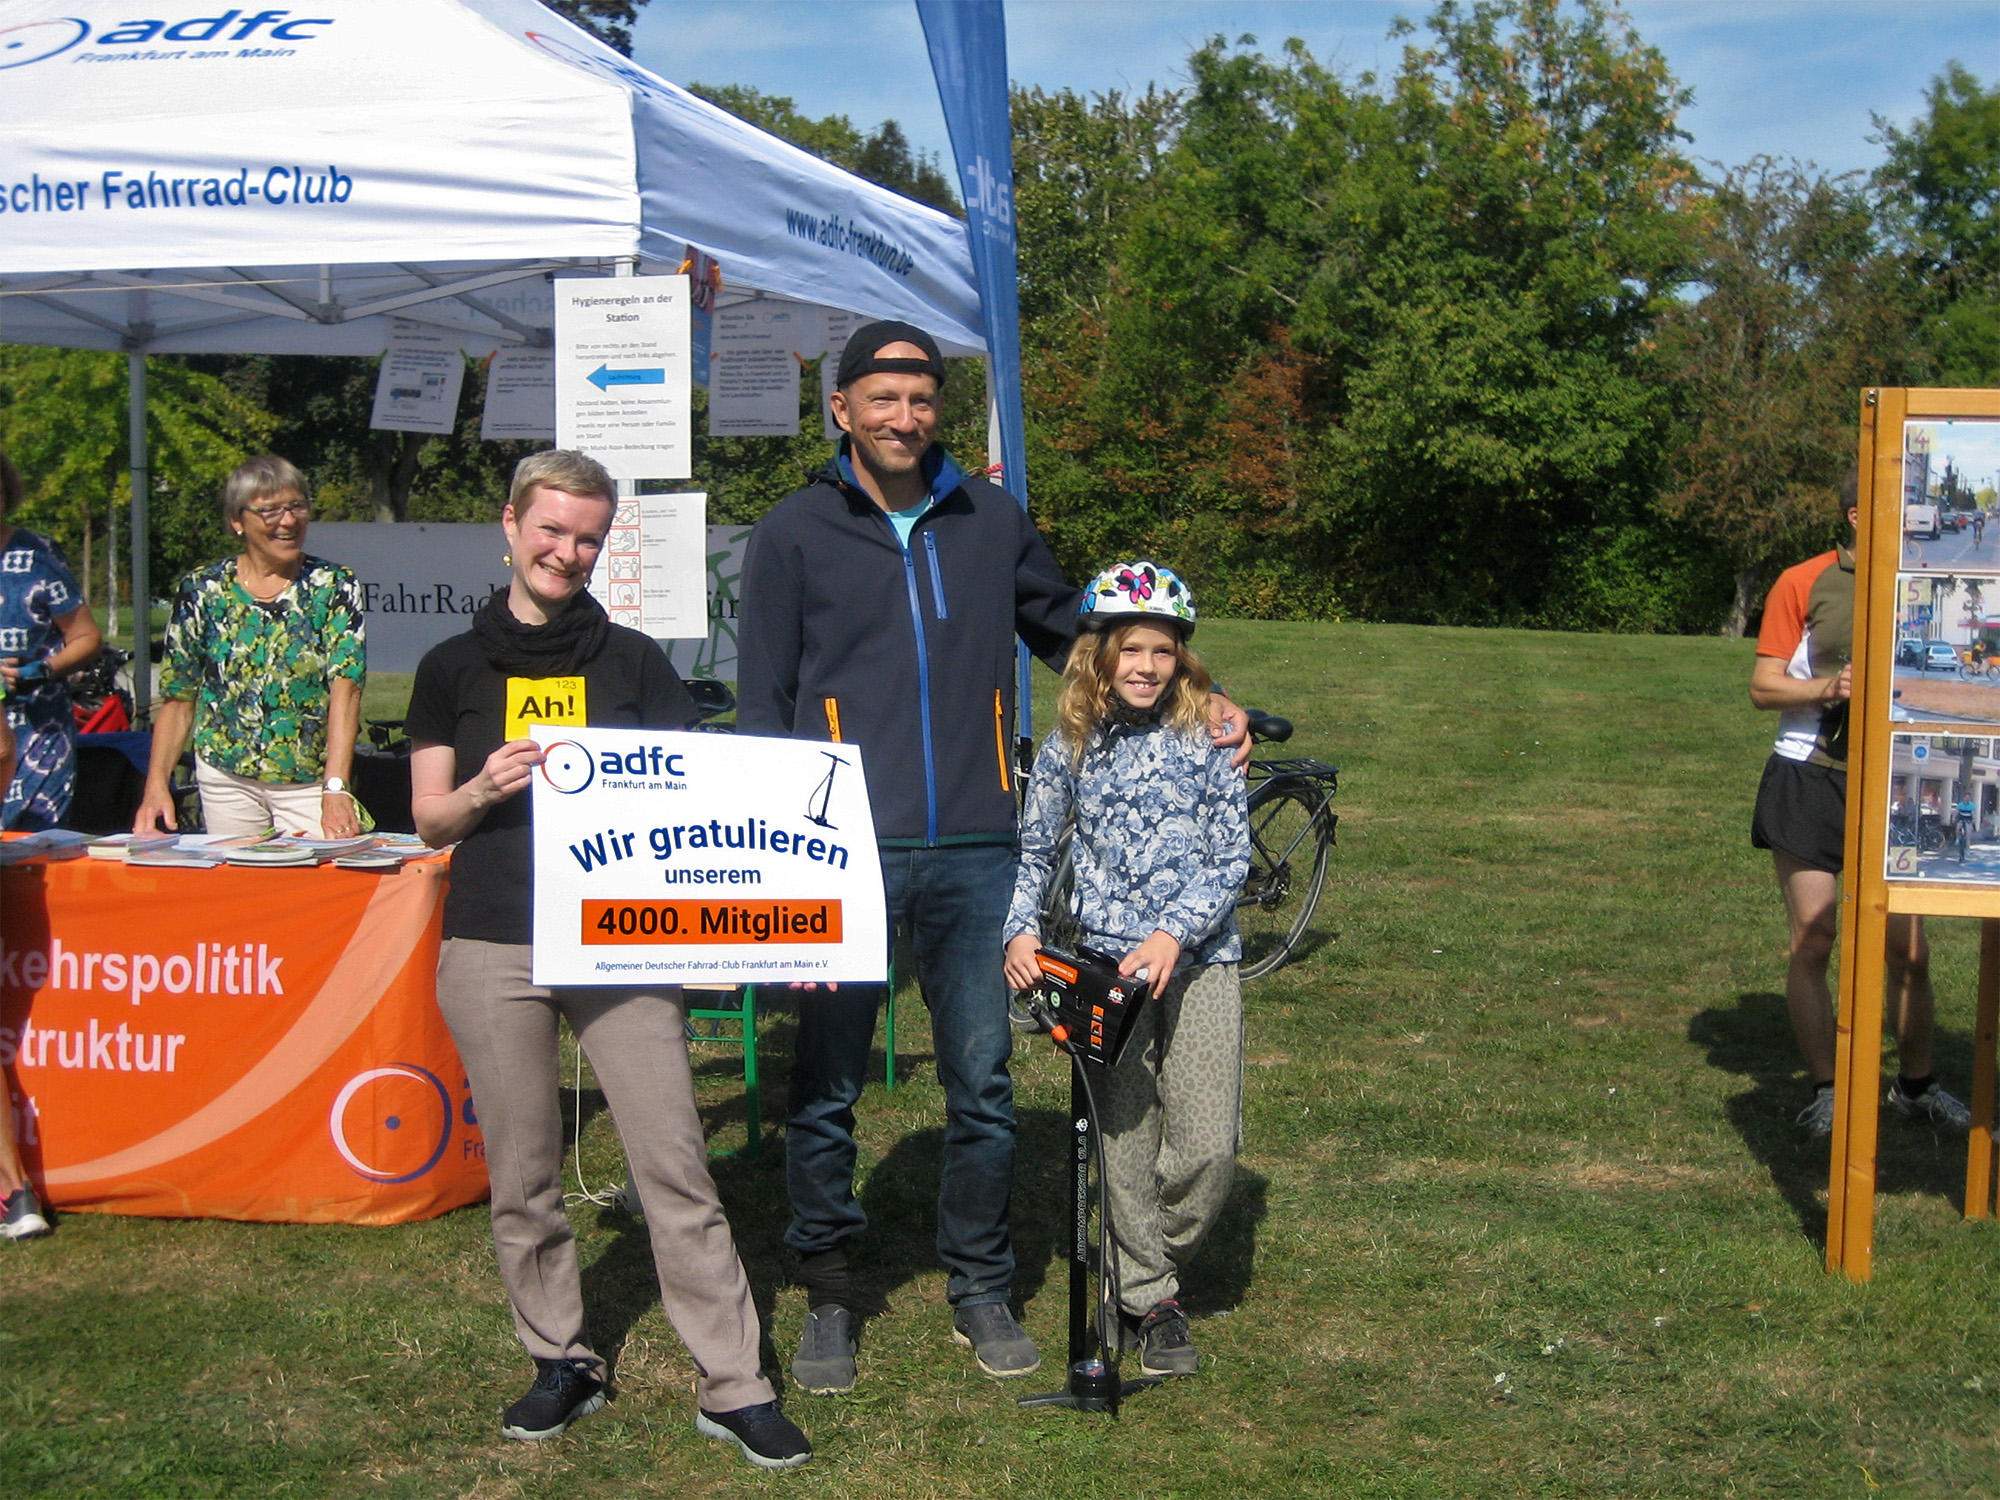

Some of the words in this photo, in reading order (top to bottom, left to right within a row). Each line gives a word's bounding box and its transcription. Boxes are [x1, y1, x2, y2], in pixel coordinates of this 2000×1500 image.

[96, 10, 335, 44] adfc
[72, 49, 184, 64] Frankfurt
[189, 50, 230, 59] am
[235, 47, 298, 58] Main
[103, 165, 353, 210] Fahrrad-Club
[572, 295, 640, 307] Hygieneregeln
[657, 294, 673, 303] der
[606, 313, 640, 322] Station
[1914, 429, 1930, 450] 4
[1907, 579, 1923, 602] 5
[556, 680, 577, 690] 123
[517, 694, 575, 719] Ah!
[600, 745, 685, 777] adfc
[602, 778, 646, 790] Frankfurt
[648, 782, 663, 790] am
[665, 780, 688, 791] Main
[569, 828, 636, 873] Wir
[649, 817, 849, 870] gratulieren
[1896, 848, 1912, 871] 6
[665, 869, 762, 884] unserem
[597, 906, 689, 936] 4000.
[701, 905, 828, 942] Mitglied
[595, 960, 643, 972] Allgemeiner
[645, 960, 686, 971] Deutscher
[688, 960, 740, 971] Fahrrad-Club
[742, 959, 778, 970] Frankfurt
[780, 961, 792, 970] am
[794, 959, 813, 970] Main
[815, 959, 829, 970] e.V.
